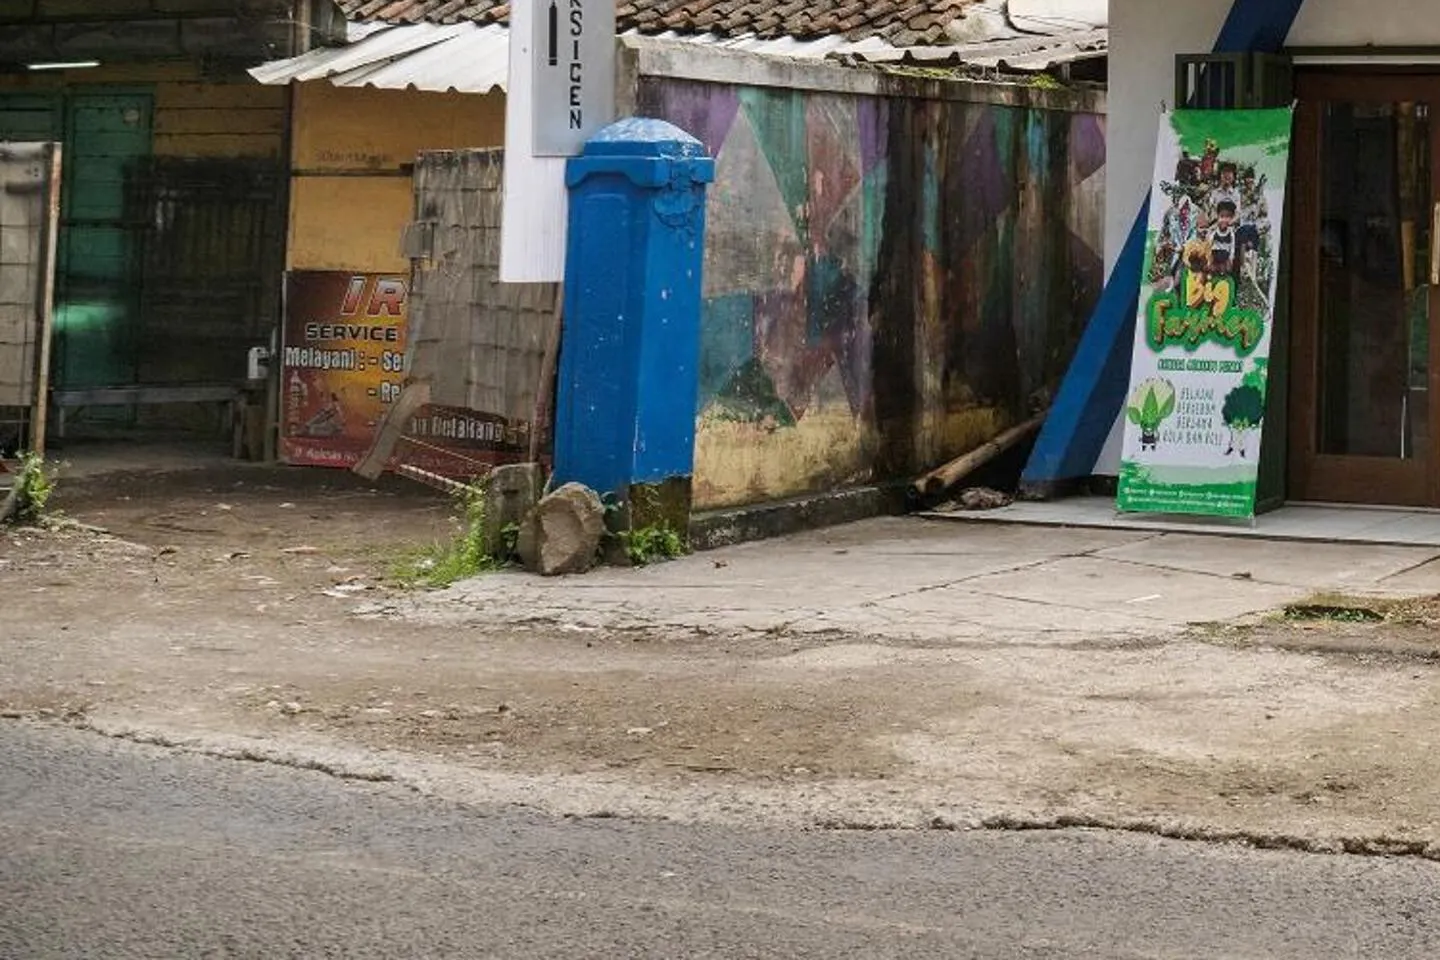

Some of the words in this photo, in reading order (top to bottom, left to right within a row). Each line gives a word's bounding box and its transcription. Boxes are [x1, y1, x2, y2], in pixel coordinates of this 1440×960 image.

[1186, 268, 1230, 316] Big
[306, 323, 398, 342] SERVICE
[285, 347, 354, 370] Melayani
